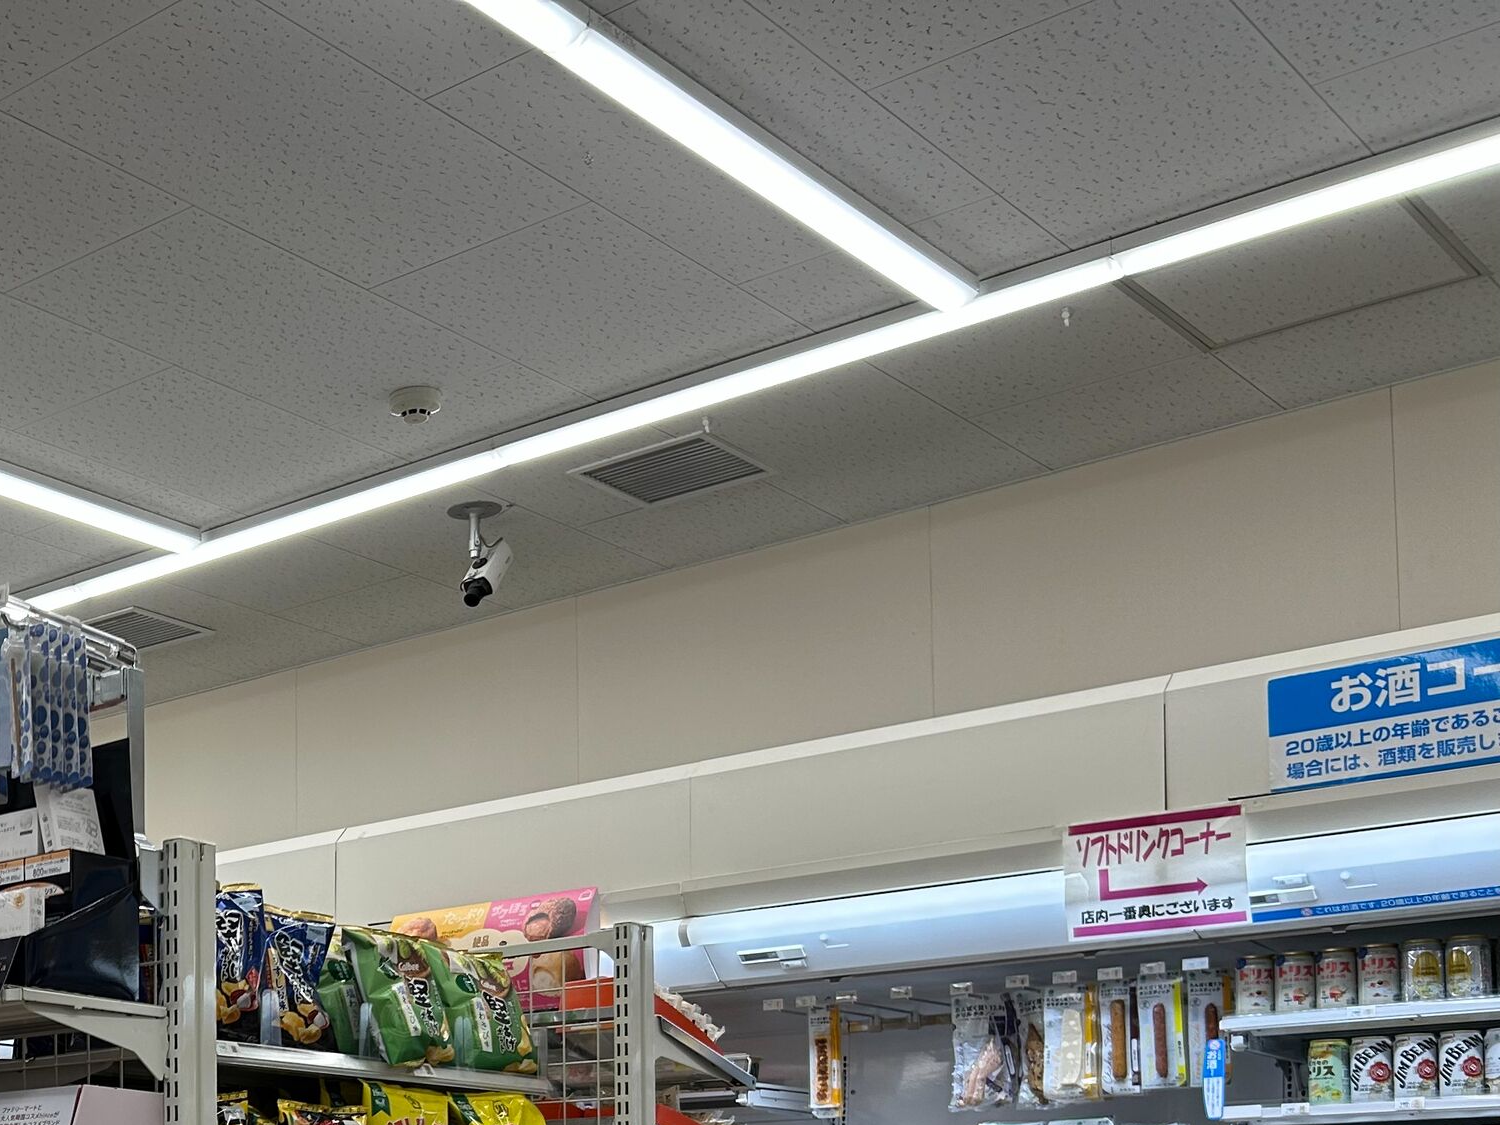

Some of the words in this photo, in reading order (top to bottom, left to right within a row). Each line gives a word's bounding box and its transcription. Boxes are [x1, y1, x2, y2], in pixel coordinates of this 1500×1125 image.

[1287, 731, 1500, 779] 場合には、酒類を販売し
[1076, 823, 1231, 868] ソフトドリンクコーナー
[1081, 896, 1235, 925] 店内一番奥にございます
[473, 935, 490, 948] 絶品
[1239, 967, 1273, 981] トリス
[1279, 963, 1313, 977] トリス
[1316, 961, 1351, 975] トリス
[1361, 958, 1397, 971] トリス
[1355, 1040, 1392, 1066] BEAM
[1395, 1060, 1408, 1088] JIM
[1402, 1037, 1437, 1064] BEAM
[1439, 1057, 1454, 1086] JIM
[1447, 1034, 1484, 1061] BEAM
[1350, 1061, 1362, 1091] JIM
